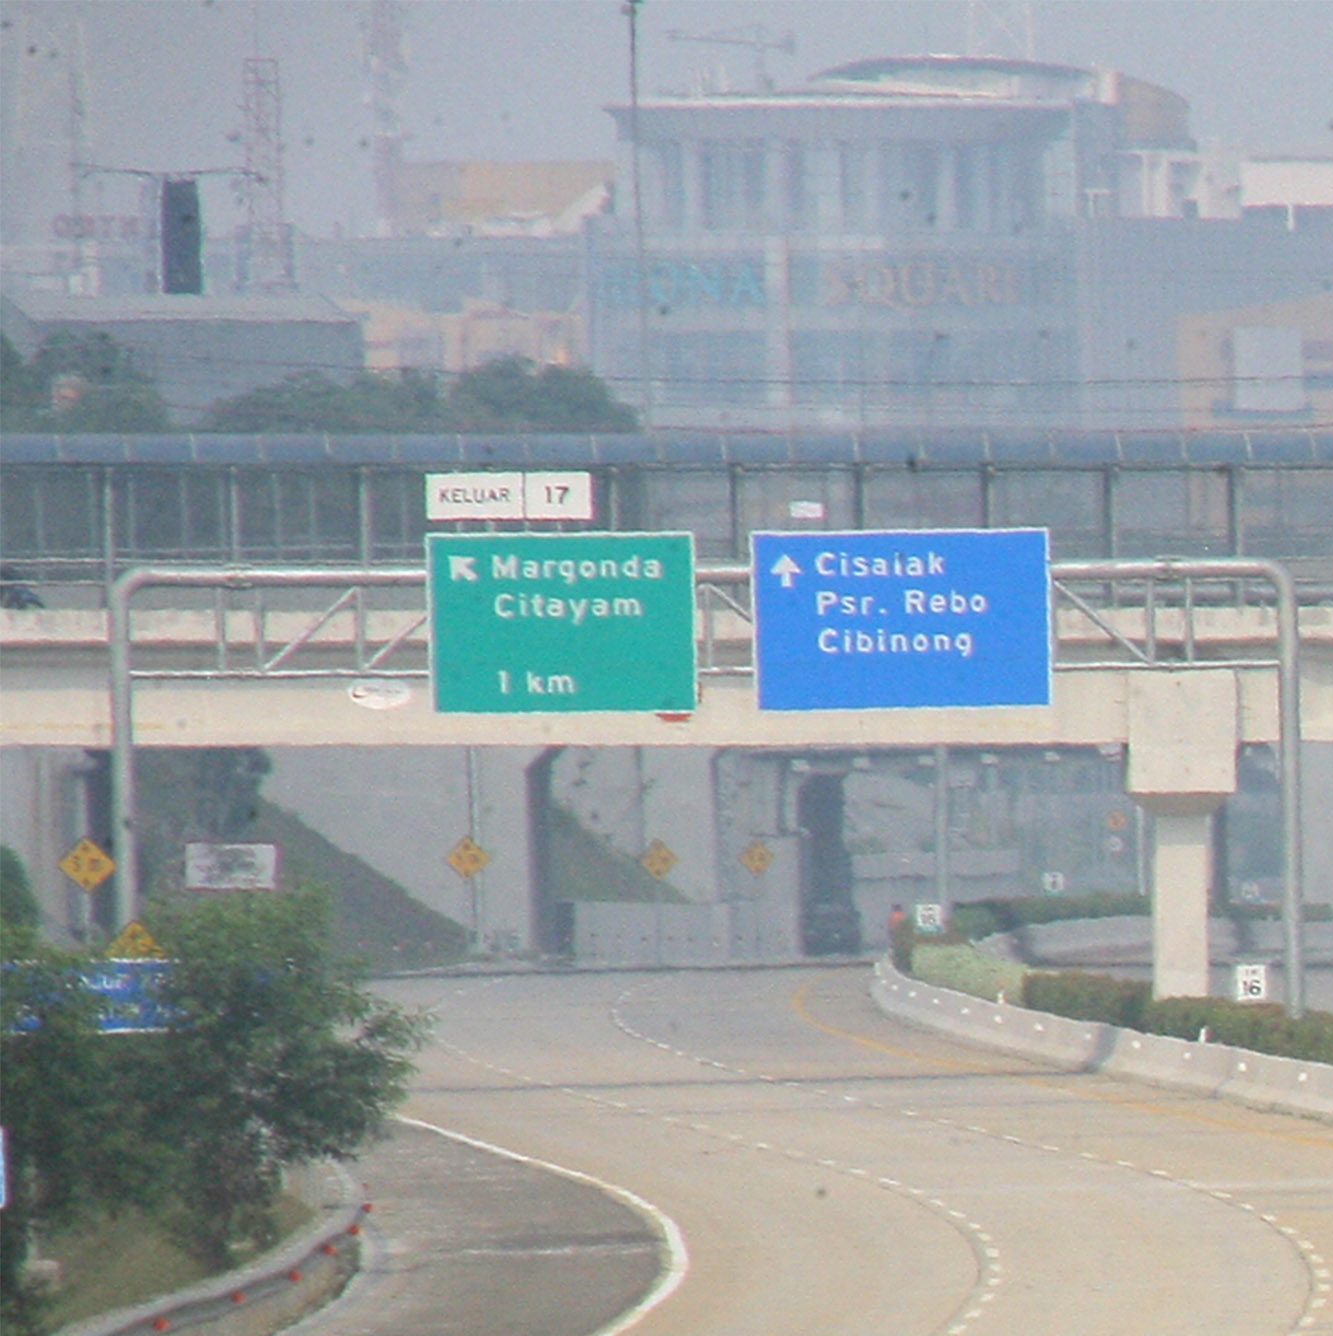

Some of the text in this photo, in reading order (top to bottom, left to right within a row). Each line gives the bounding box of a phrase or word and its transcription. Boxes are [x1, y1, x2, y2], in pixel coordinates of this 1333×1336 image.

[438, 486, 569, 504] KELUAR 17
[491, 555, 663, 585] Margonda
[494, 593, 644, 625] Citayam
[815, 589, 988, 616] Psr. Rebo
[817, 628, 974, 658] Cibinong
[498, 670, 577, 695] 1 km
